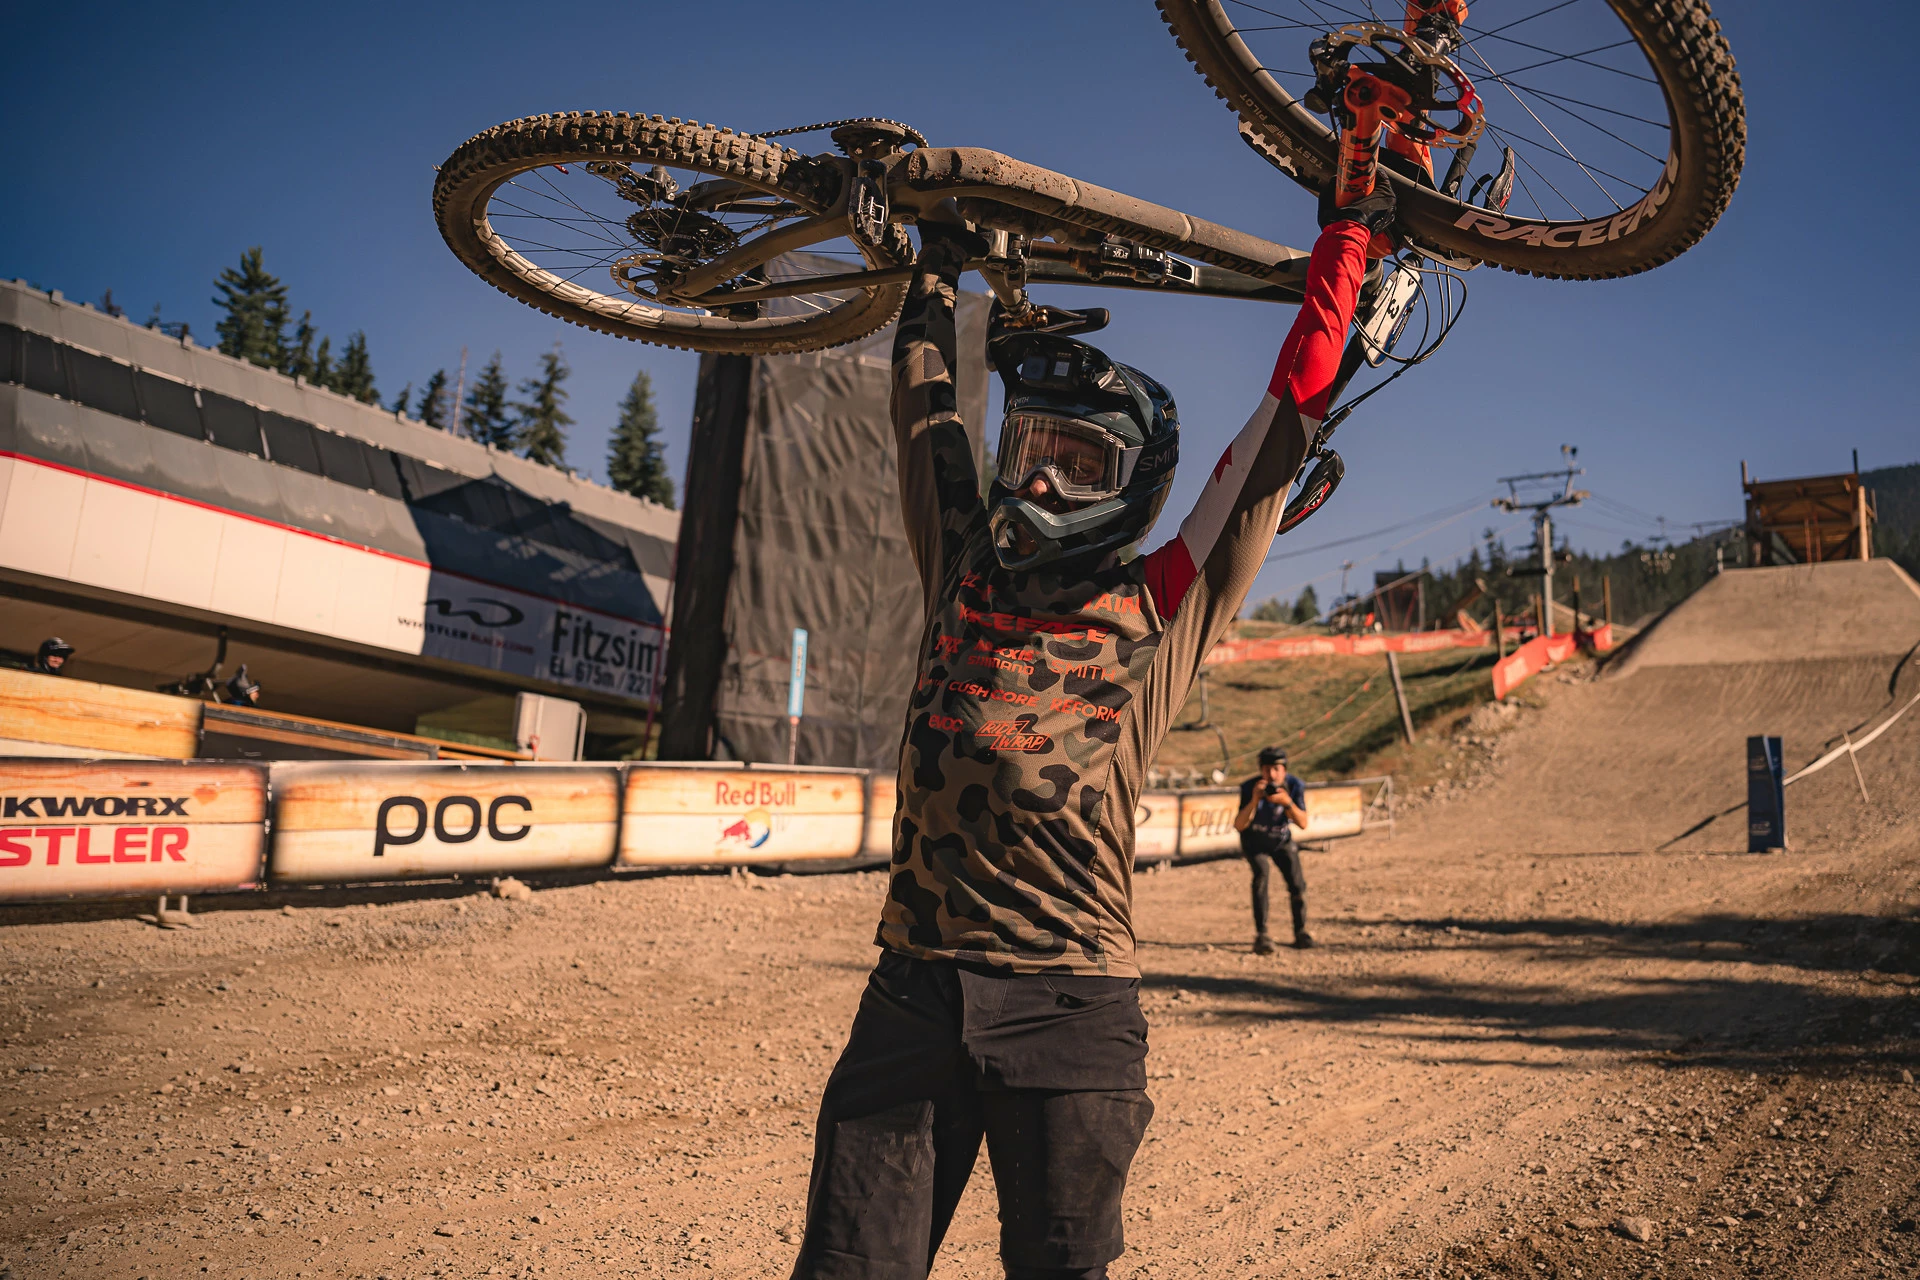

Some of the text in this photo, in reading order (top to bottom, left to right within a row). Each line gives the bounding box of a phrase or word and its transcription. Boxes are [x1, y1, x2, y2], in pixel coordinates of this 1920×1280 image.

[1239, 93, 1268, 122] PILOT
[1387, 298, 1399, 319] 3
[967, 655, 1035, 676] SHIMANO
[1050, 659, 1116, 682] SMITH
[1050, 698, 1122, 724] REFORM
[982, 721, 1020, 735] RIDE
[999, 735, 1045, 749] WRAP
[715, 781, 796, 806] Red Bull
